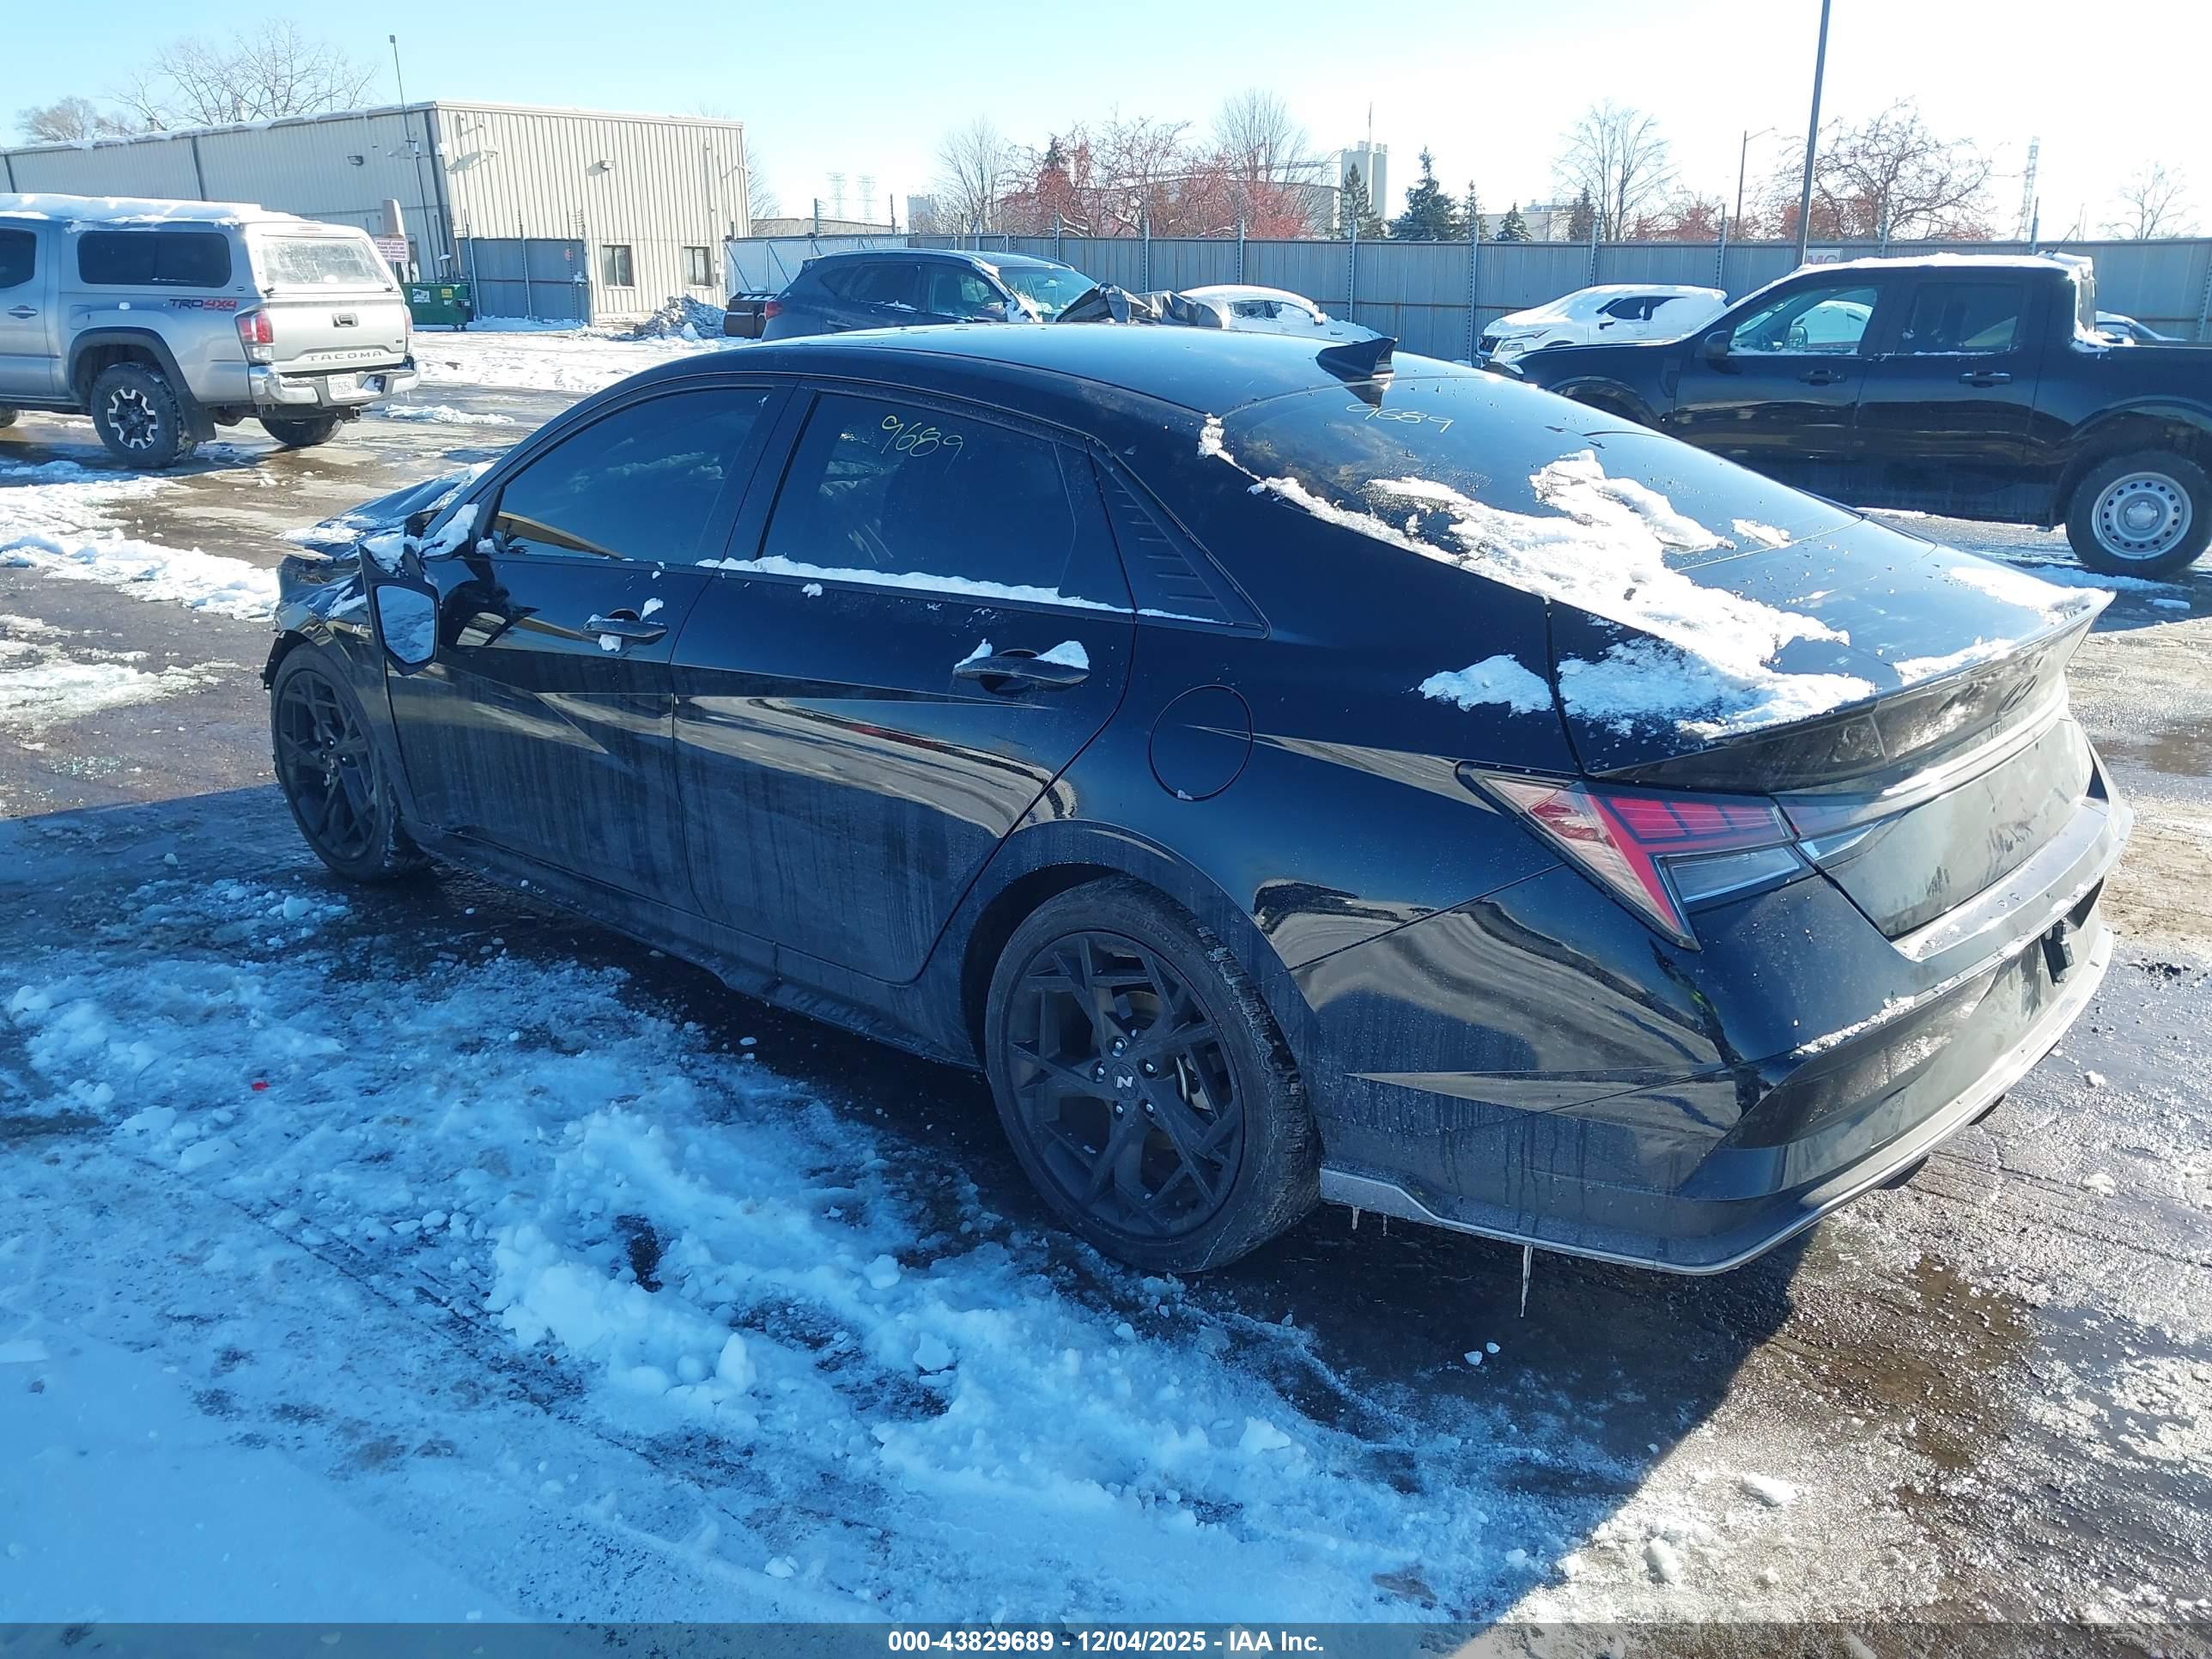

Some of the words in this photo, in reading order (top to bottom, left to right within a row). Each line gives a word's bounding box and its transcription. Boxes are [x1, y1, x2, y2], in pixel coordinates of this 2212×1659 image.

[169, 298, 204, 309] TRD
[307, 350, 382, 362] TACOMA
[1346, 403, 1455, 434] 9689
[881, 414, 963, 474] 9689
[1116, 1076, 1133, 1089] N
